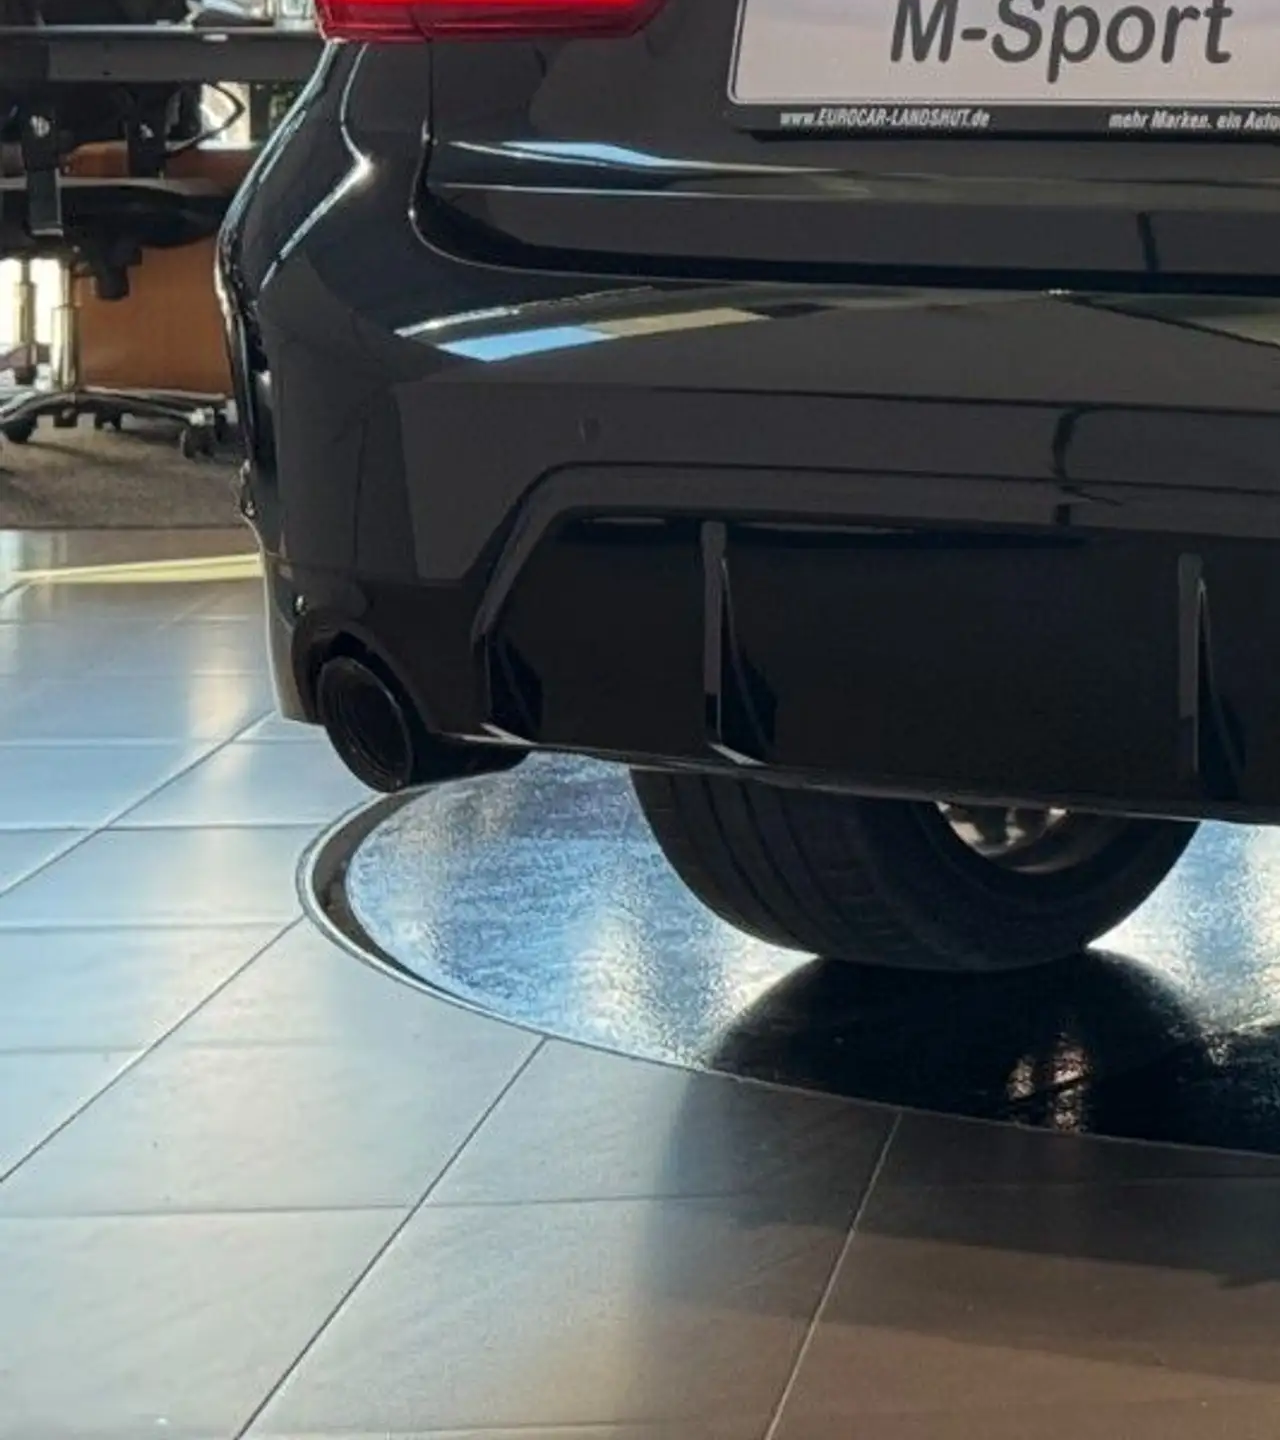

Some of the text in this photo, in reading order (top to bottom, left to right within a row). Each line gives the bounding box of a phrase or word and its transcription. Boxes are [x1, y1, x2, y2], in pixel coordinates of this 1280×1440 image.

[780, 108, 990, 127] www.EUROCAR-LANDSHUT.de
[1109, 109, 1149, 128] mehr
[1216, 111, 1242, 129] ein
